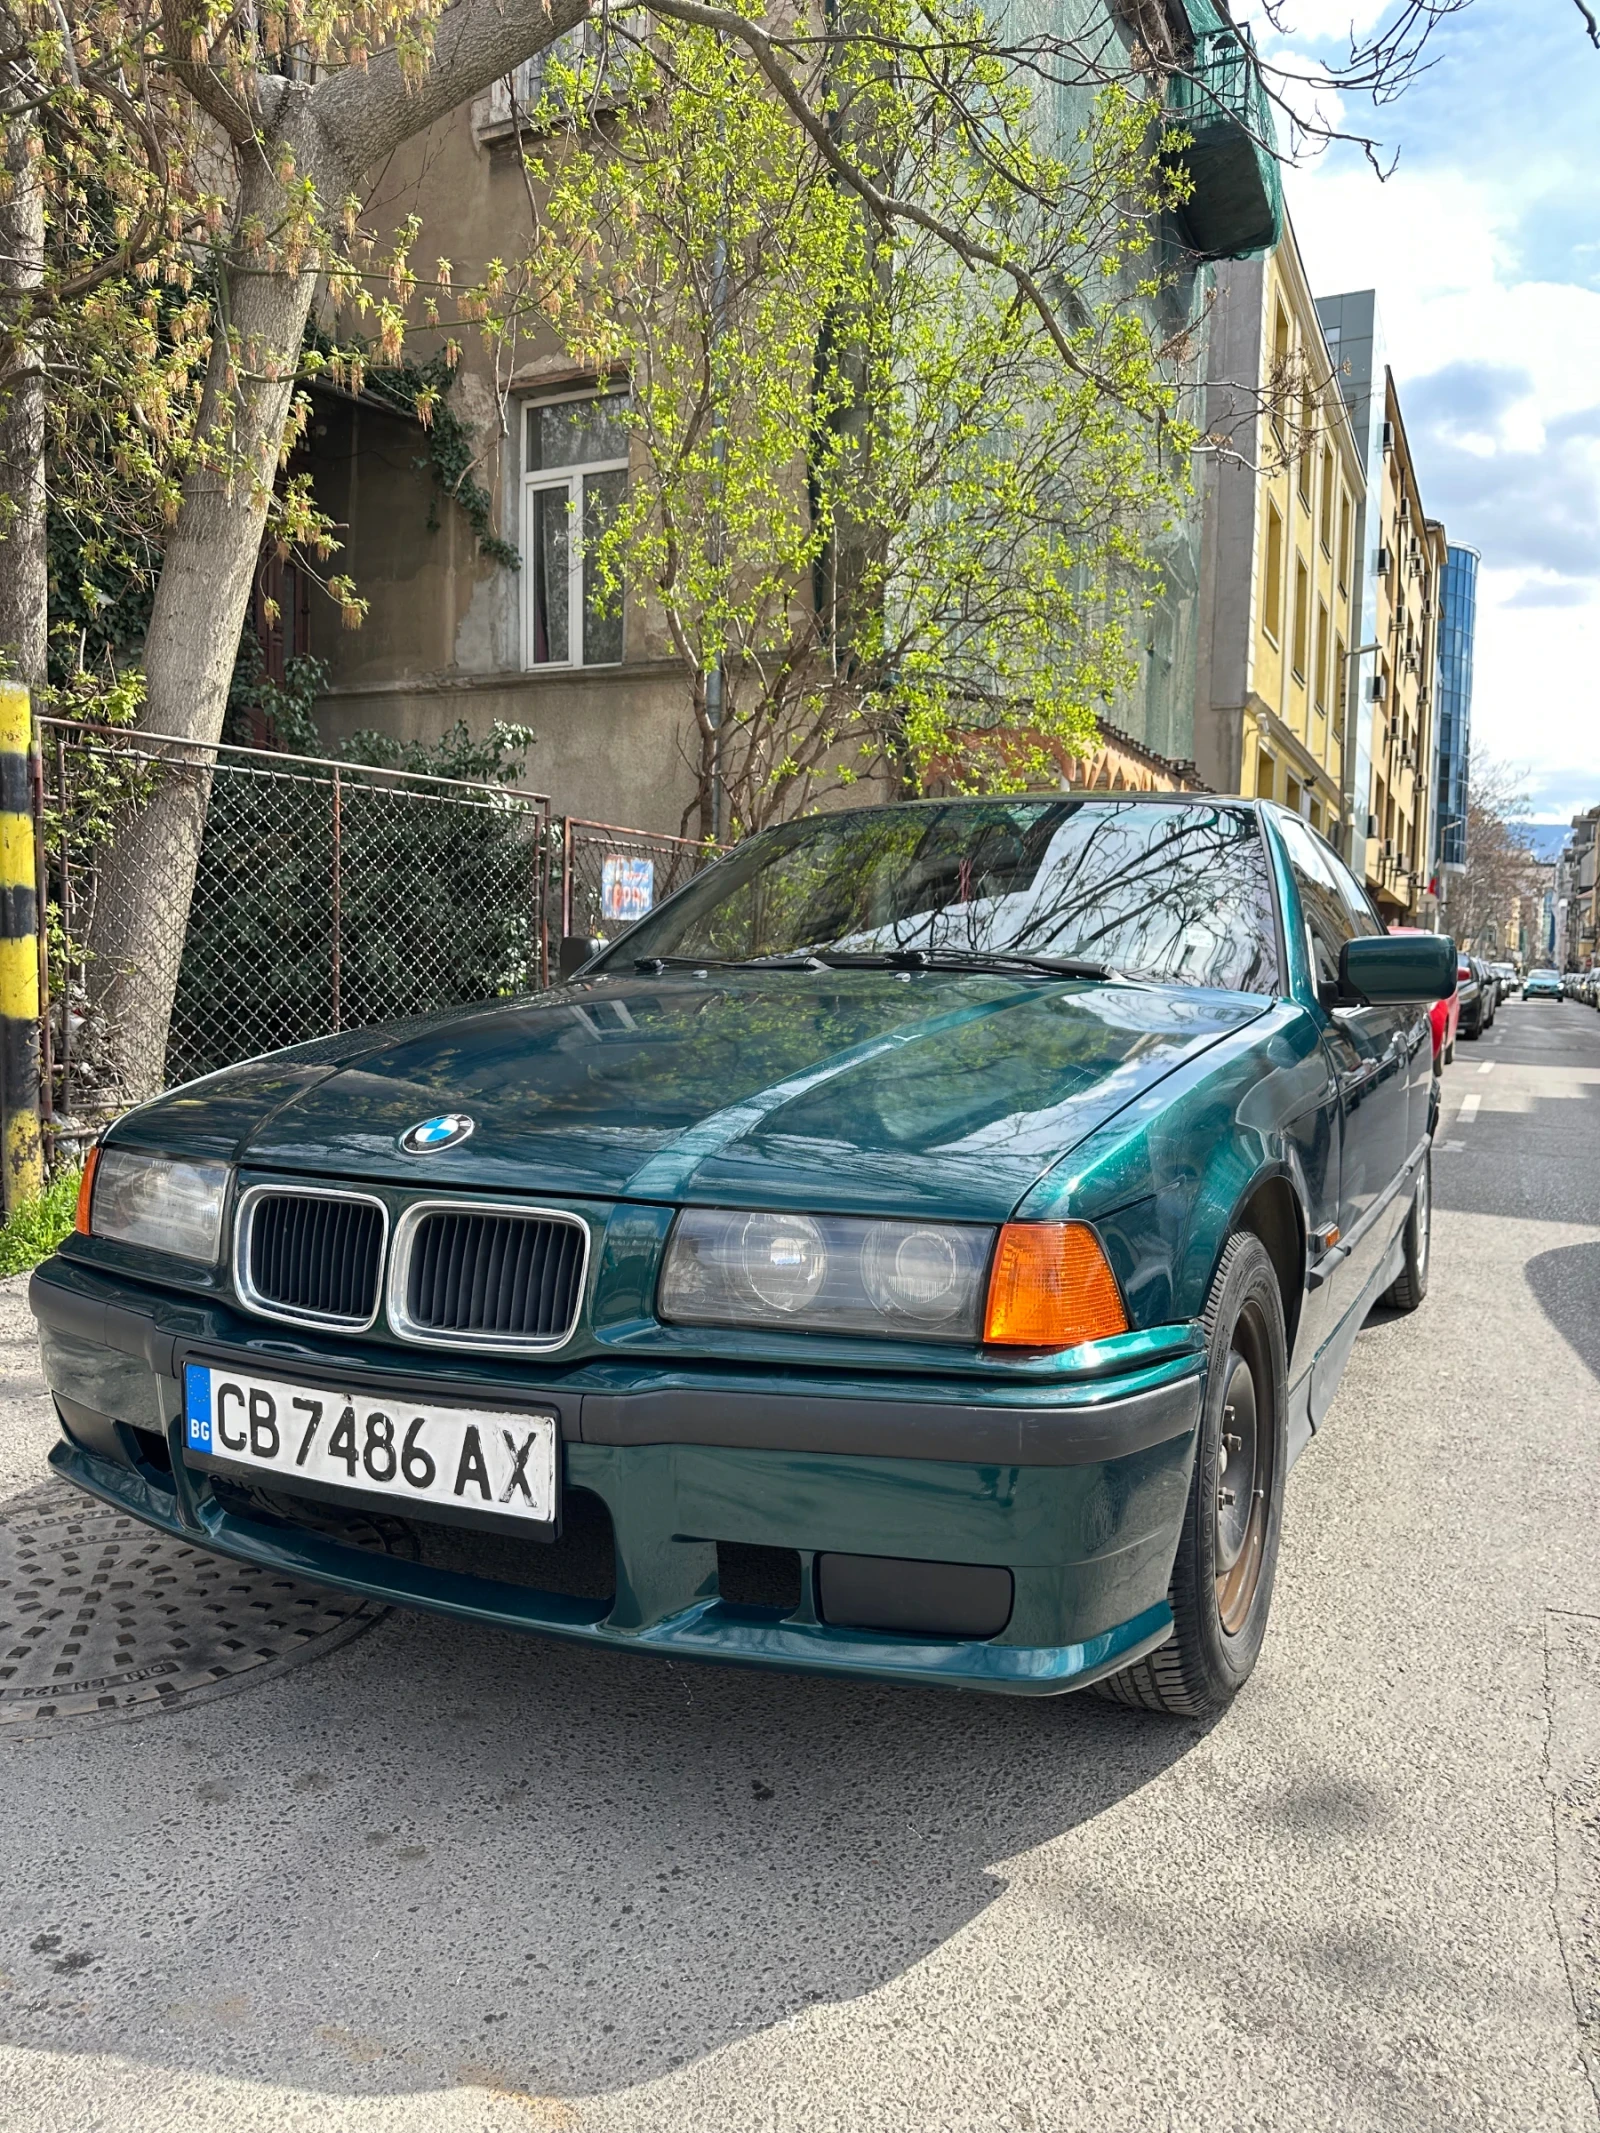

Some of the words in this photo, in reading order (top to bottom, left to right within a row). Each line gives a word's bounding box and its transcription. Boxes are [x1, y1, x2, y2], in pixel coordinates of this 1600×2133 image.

[190, 1418, 210, 1441] BG
[217, 1382, 280, 1459] CB
[292, 1396, 437, 1490] 7486
[453, 1423, 539, 1508] AX
[124, 1663, 166, 1681] DIN
